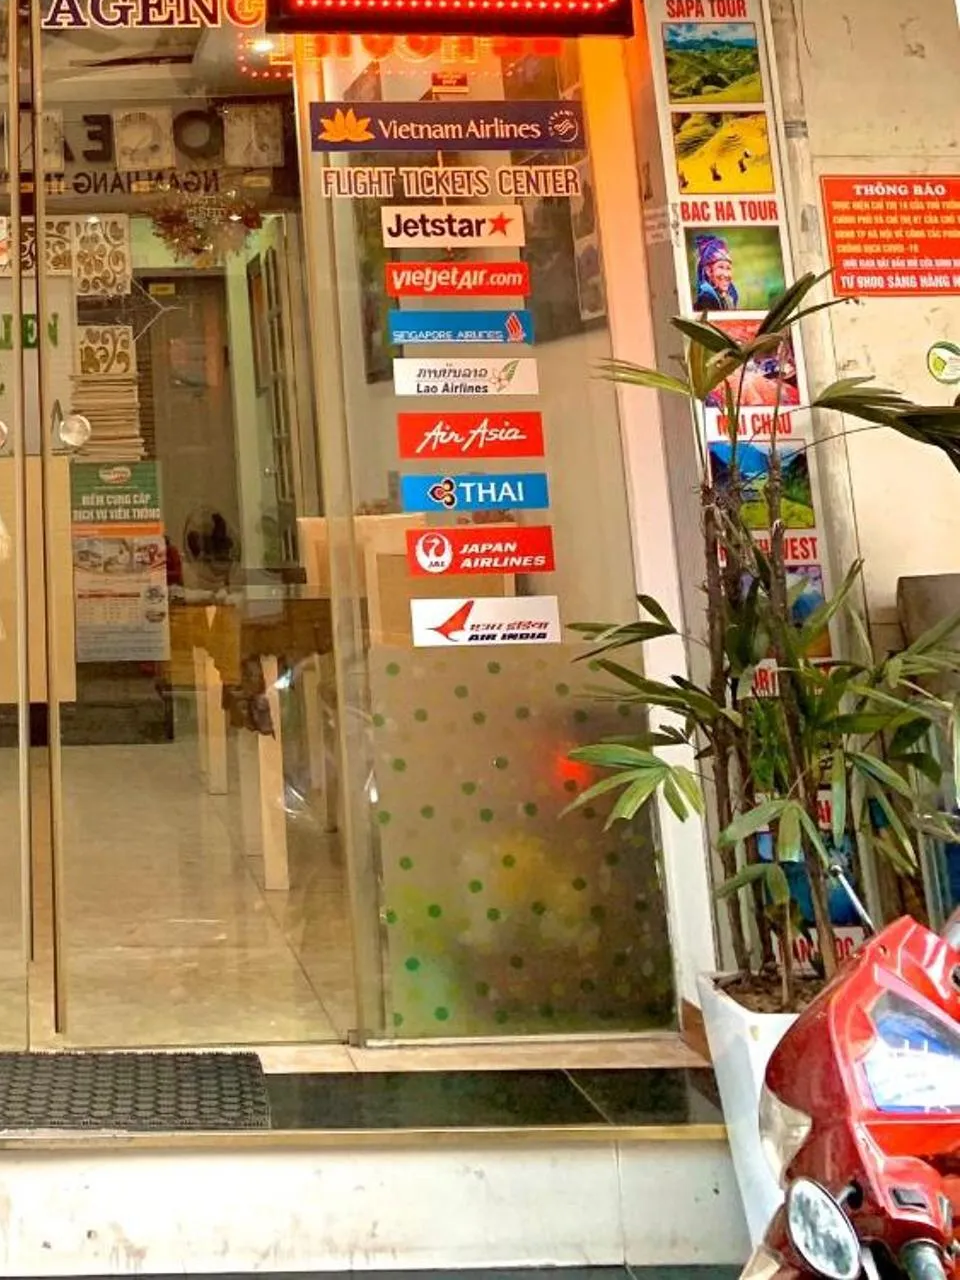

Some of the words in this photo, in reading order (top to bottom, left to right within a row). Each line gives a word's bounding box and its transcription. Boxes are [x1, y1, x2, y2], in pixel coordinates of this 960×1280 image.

[377, 120, 464, 140] Vietnam
[466, 118, 541, 140] Airlines
[321, 167, 395, 198] FLIGHT
[400, 166, 490, 197] TICKETS
[497, 165, 581, 196] CENTER
[852, 182, 909, 196] THÔNG
[680, 201, 711, 221] BAC
[714, 201, 735, 221] HA
[738, 200, 779, 221] TOUR
[387, 213, 487, 238] Jetstar
[392, 330, 453, 340] SINGAPORE
[416, 383, 439, 394] Lao
[441, 382, 489, 394] Airlines
[459, 481, 525, 503] THAI
[460, 542, 518, 554] JAPAN
[460, 556, 546, 569] AIRLINES
[468, 633, 498, 642] AIR
[501, 632, 548, 641] INDIA
